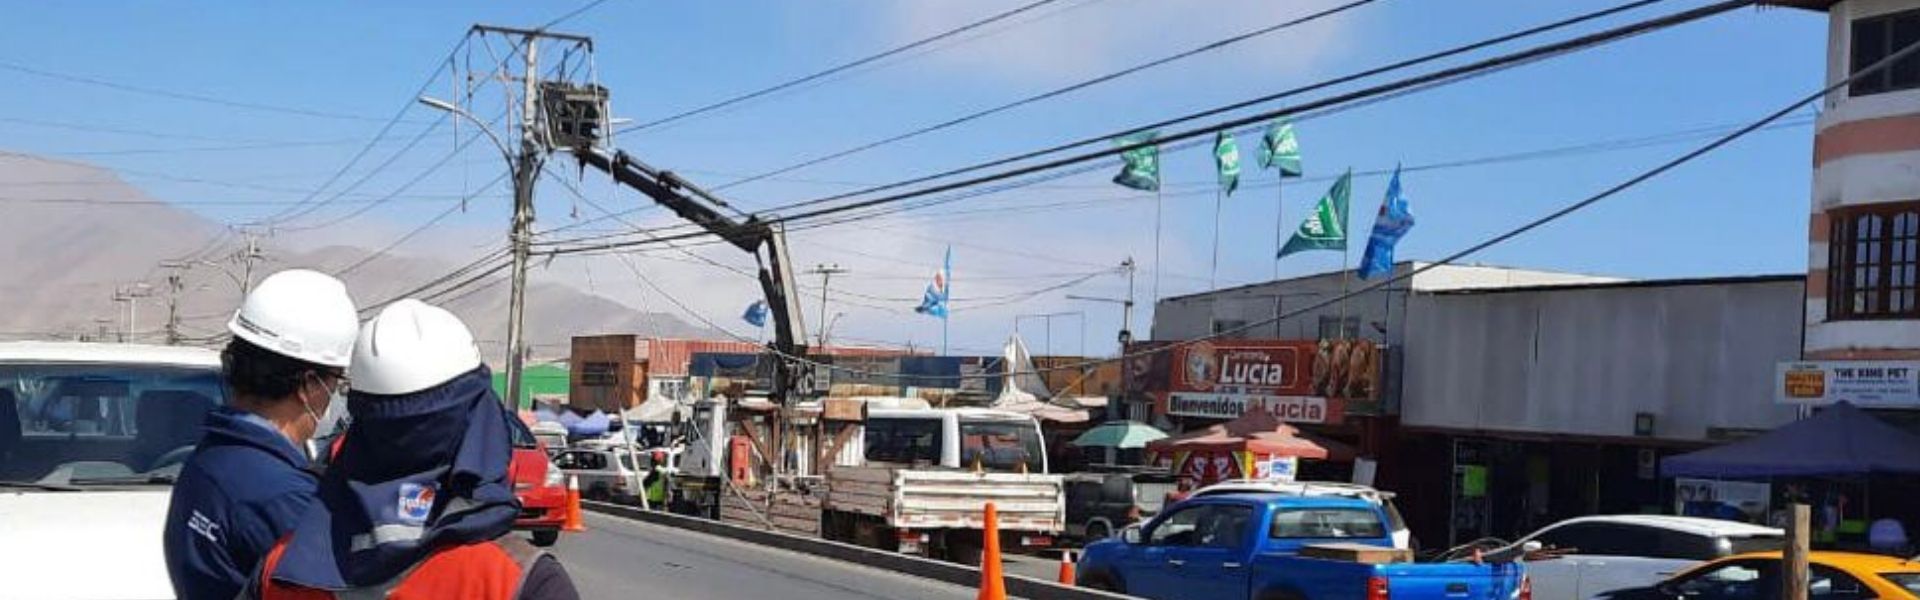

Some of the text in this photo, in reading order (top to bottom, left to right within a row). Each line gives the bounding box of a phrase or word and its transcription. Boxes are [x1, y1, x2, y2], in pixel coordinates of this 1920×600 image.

[1834, 367, 1855, 378] THE
[1887, 367, 1909, 378] PET
[1170, 395, 1245, 417] Bienvenidos
[187, 509, 220, 542] SEC
